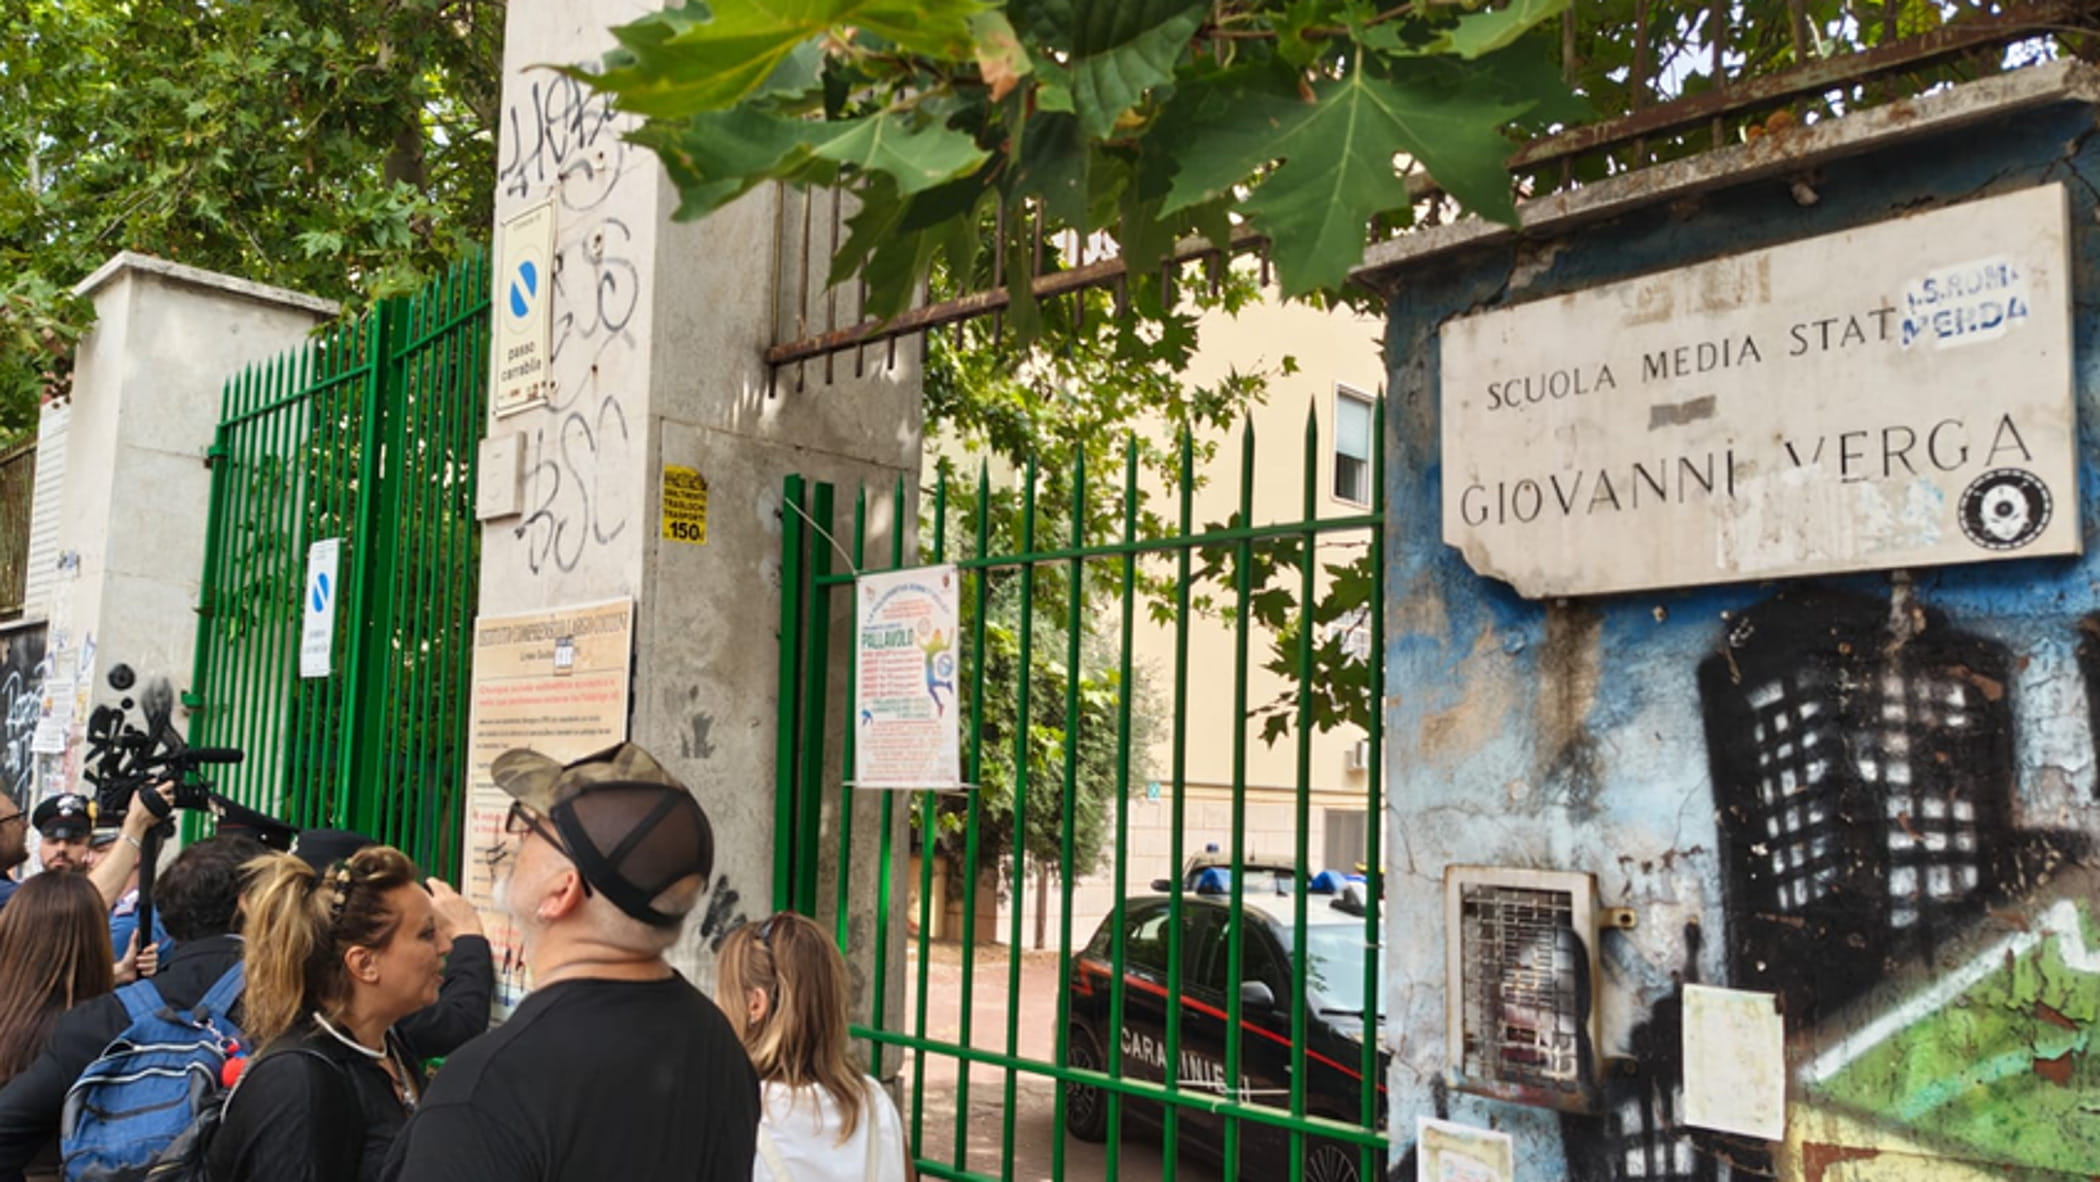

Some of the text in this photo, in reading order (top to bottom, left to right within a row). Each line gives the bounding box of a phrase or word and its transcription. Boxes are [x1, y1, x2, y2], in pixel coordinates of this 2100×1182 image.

[501, 357, 543, 383] carrabile
[508, 341, 536, 363] passo
[1486, 363, 1617, 411] SCUOLA
[1641, 335, 1762, 384] MEDIA
[1460, 412, 2032, 517] GIOVANNI VERGA
[862, 628, 913, 650] PALLAVOLO
[1119, 1027, 1251, 1105] CARAINIEI
